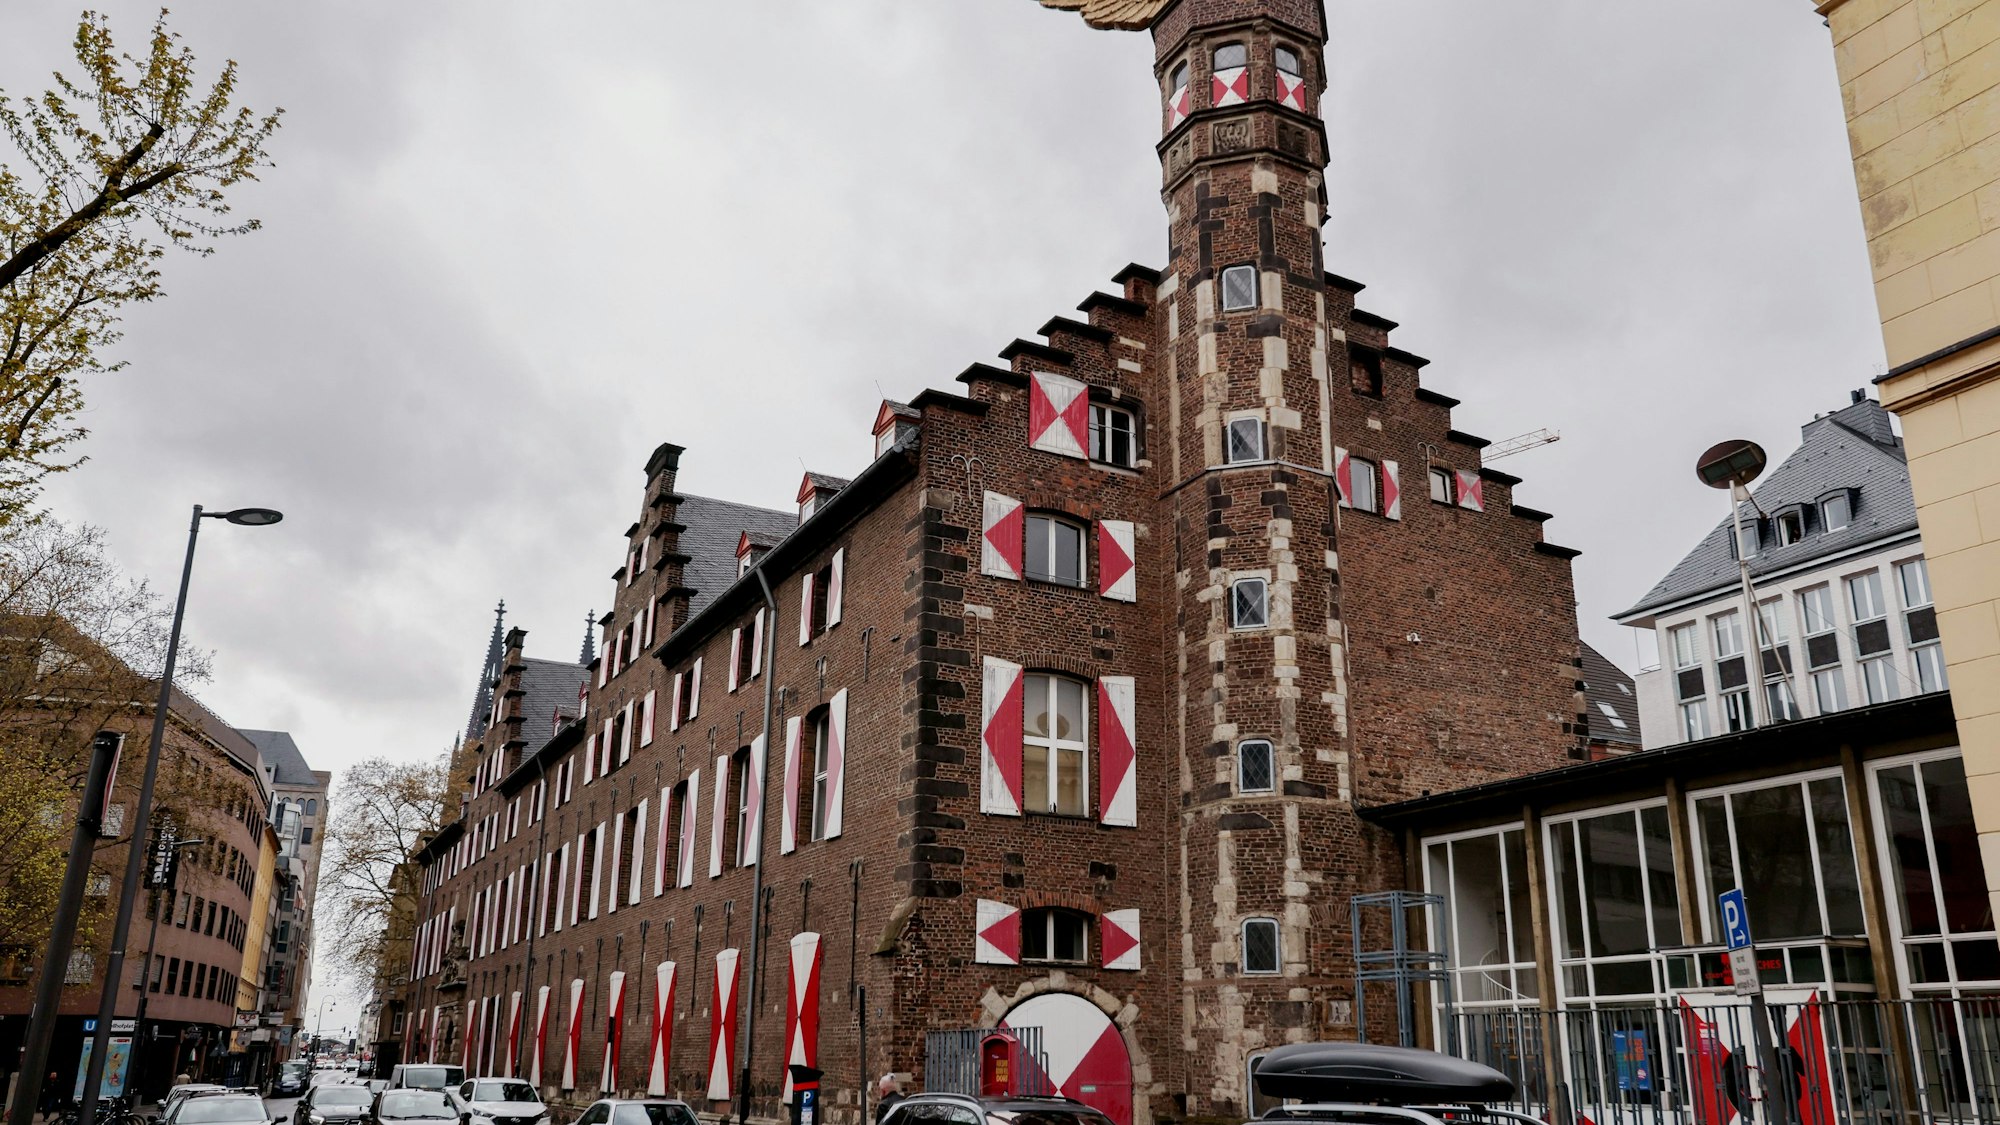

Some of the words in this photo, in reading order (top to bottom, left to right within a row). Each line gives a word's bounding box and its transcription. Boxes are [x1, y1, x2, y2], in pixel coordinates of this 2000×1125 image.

[1724, 900, 1739, 947] P
[1757, 959, 1782, 970] CHES
[85, 1020, 95, 1031] U
[803, 1090, 811, 1104] P
